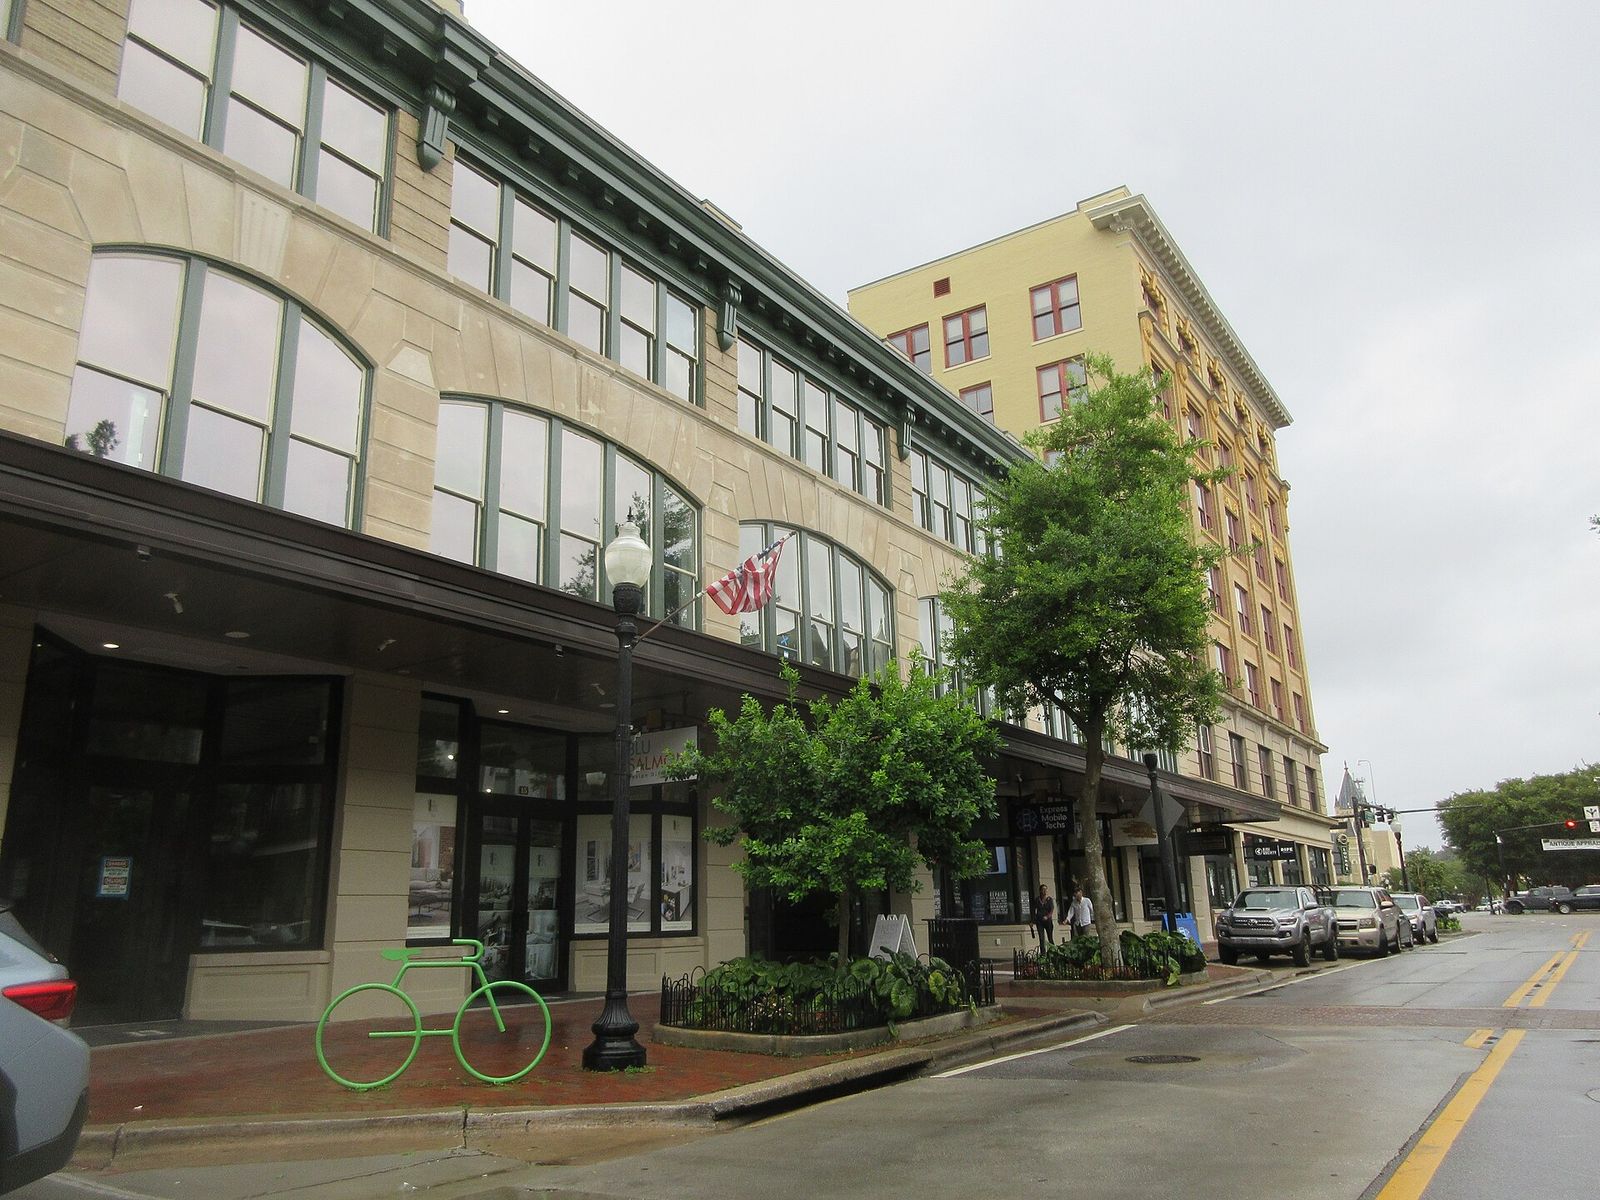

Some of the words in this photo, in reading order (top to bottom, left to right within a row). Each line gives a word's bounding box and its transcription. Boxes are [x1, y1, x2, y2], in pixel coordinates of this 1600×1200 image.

[629, 752, 688, 771] SALM
[1040, 806, 1068, 814] Express
[1045, 821, 1066, 829] Techs
